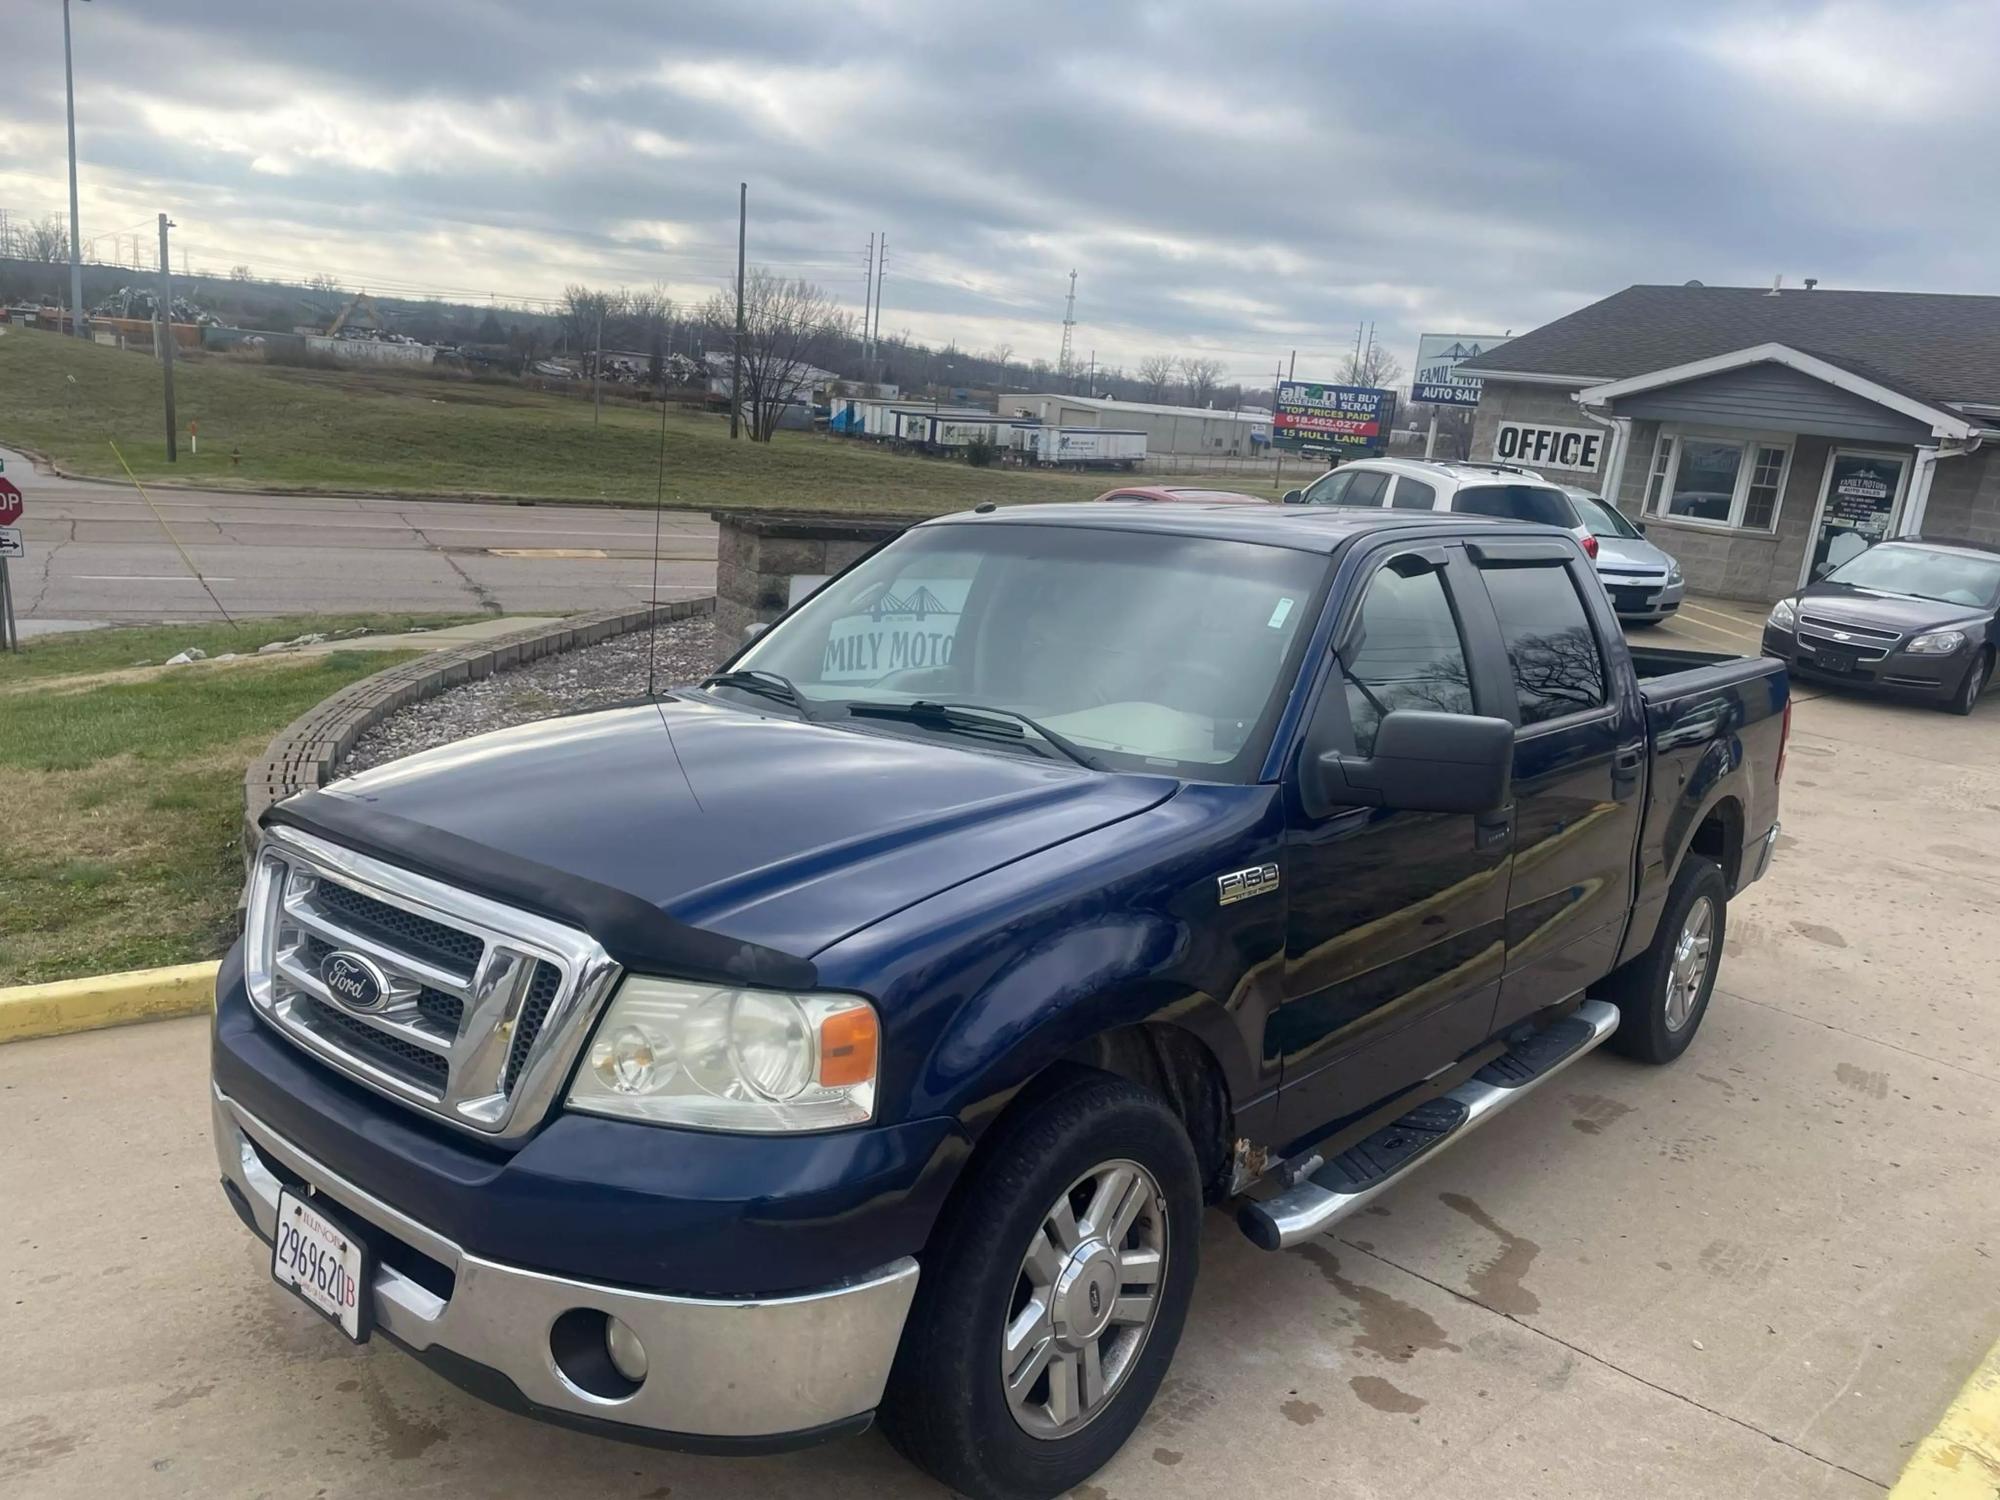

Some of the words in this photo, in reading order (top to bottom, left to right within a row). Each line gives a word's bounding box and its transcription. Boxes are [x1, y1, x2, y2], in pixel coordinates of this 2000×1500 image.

[1340, 392, 1355, 402] WE
[1359, 393, 1380, 404] BUY
[1422, 387, 1452, 400] AUTO
[1279, 397, 1336, 409] MATERIALS
[1340, 402, 1376, 412] SCRAP
[1308, 408, 1344, 418] PRICES
[1286, 415, 1367, 430] 618.462.0277
[1282, 428, 1296, 437] 15
[1299, 430, 1331, 441] HULL
[1335, 434, 1368, 445] LANE
[1498, 427, 1600, 467] OFFICE
[823, 632, 883, 672] MILY
[328, 959, 367, 999] Ford
